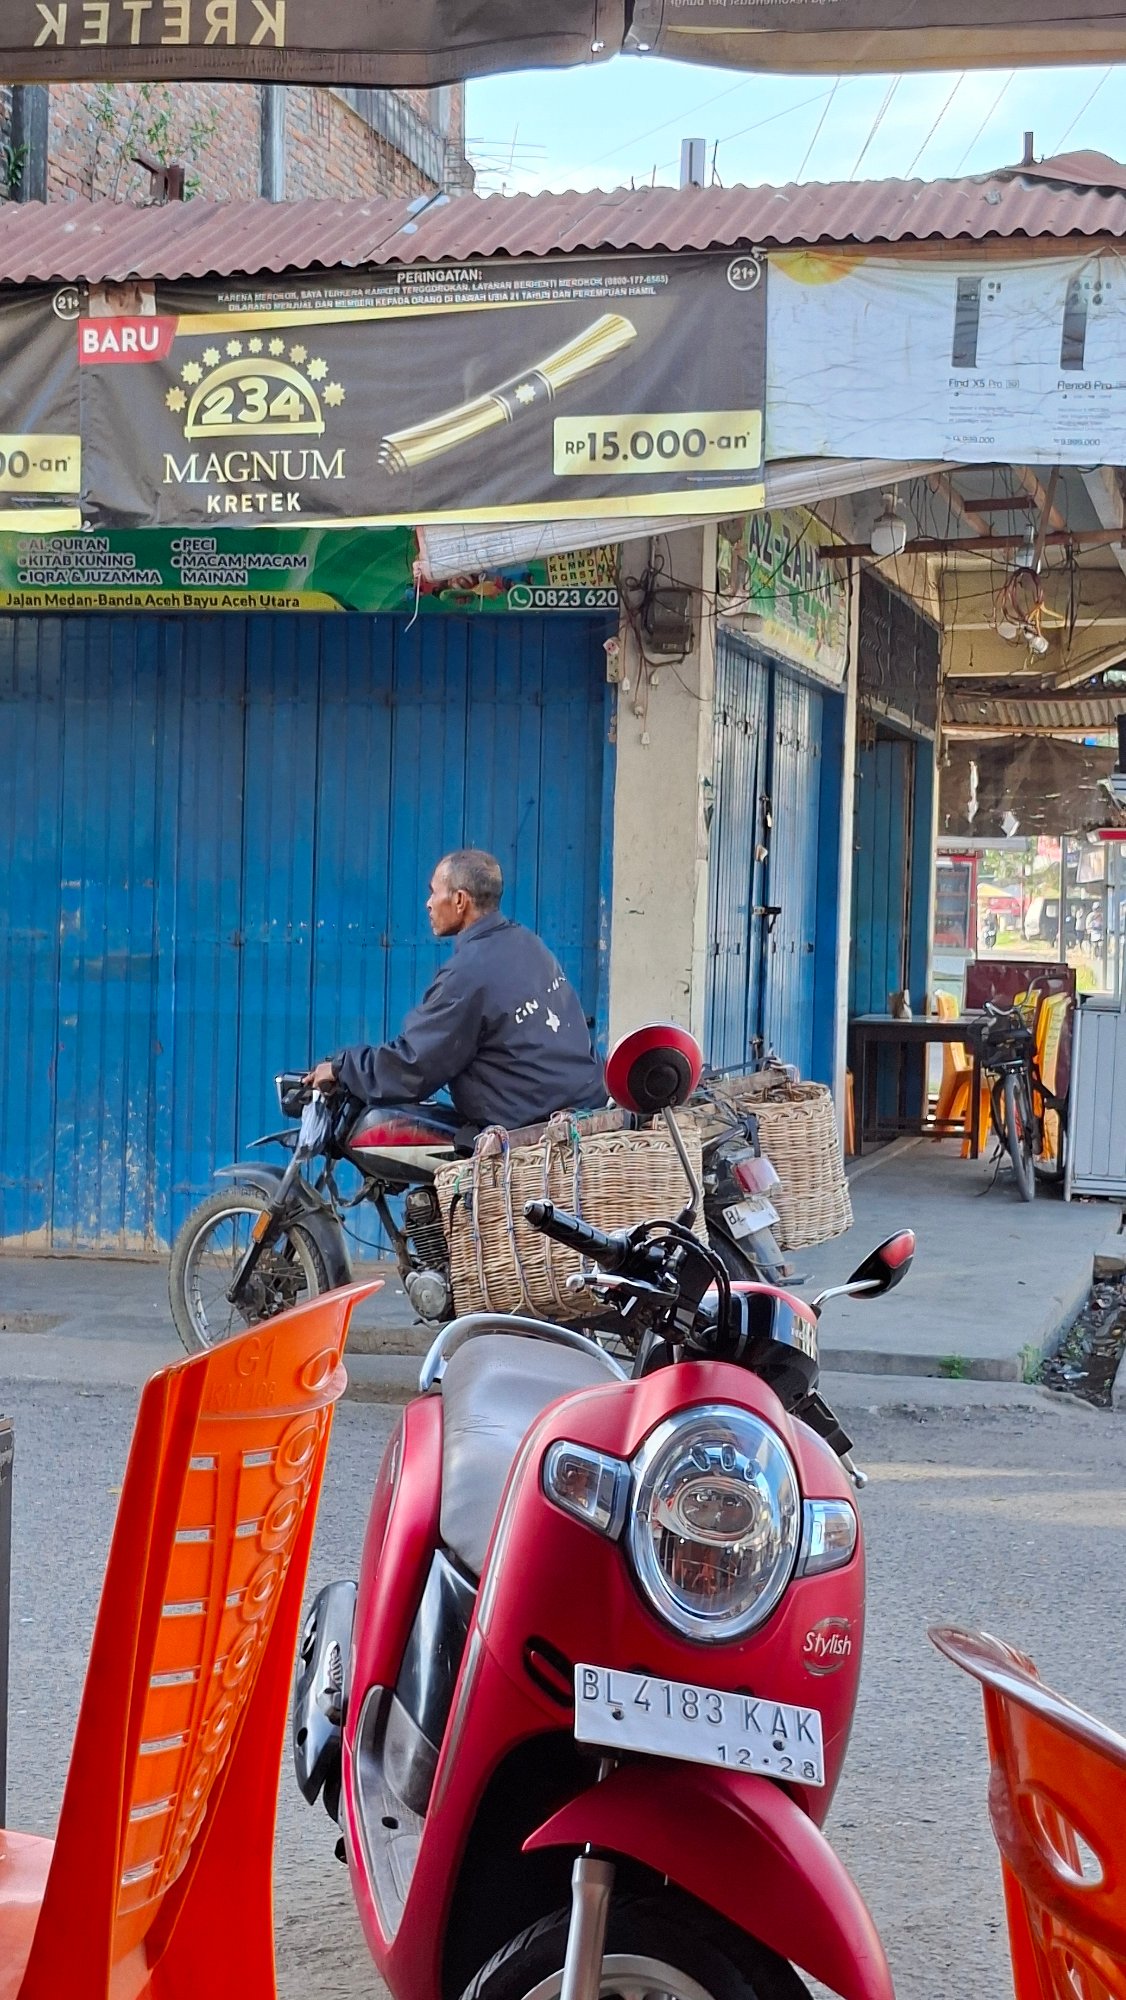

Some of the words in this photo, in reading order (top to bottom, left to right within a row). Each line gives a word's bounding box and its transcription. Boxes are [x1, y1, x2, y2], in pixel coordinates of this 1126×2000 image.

[397, 268, 484, 284] PERINGATAN:
[732, 267, 756, 280] 21+
[57, 295, 79, 310] 21+
[228, 302, 272, 312] DILARANG
[411, 294, 442, 305] ORANG
[628, 286, 656, 296] HAMIL
[82, 326, 160, 353] BARU
[948, 378, 969, 389] Find
[988, 379, 1003, 389] Pro
[1094, 381, 1112, 391] Pro
[201, 377, 305, 425] 234
[162, 448, 347, 484] MAGNUM
[206, 492, 302, 513] KRETEK
[183, 538, 215, 552] PECI
[28, 555, 72, 567] KITAB
[75, 555, 134, 568] KUNING
[183, 555, 307, 568] MACAM-MACAM
[29, 571, 69, 585] IQRA'
[71, 572, 82, 584] &
[84, 571, 161, 584] JUZAMMA
[183, 571, 246, 584] MAINAN
[6, 592, 42, 608] Jalan
[44, 592, 142, 607] Medan-Banda
[145, 593, 181, 607] Aceh
[183, 593, 217, 609] Bayu
[221, 594, 257, 608] Aceh
[259, 594, 300, 608] Utara
[534, 589, 580, 606] 0823
[584, 589, 619, 606] 620
[725, 1206, 747, 1225] BL
[803, 1631, 851, 1656] Stylish
[582, 1668, 624, 1707] BL
[634, 1680, 724, 1725] 4183
[743, 1698, 815, 1745] KAK
